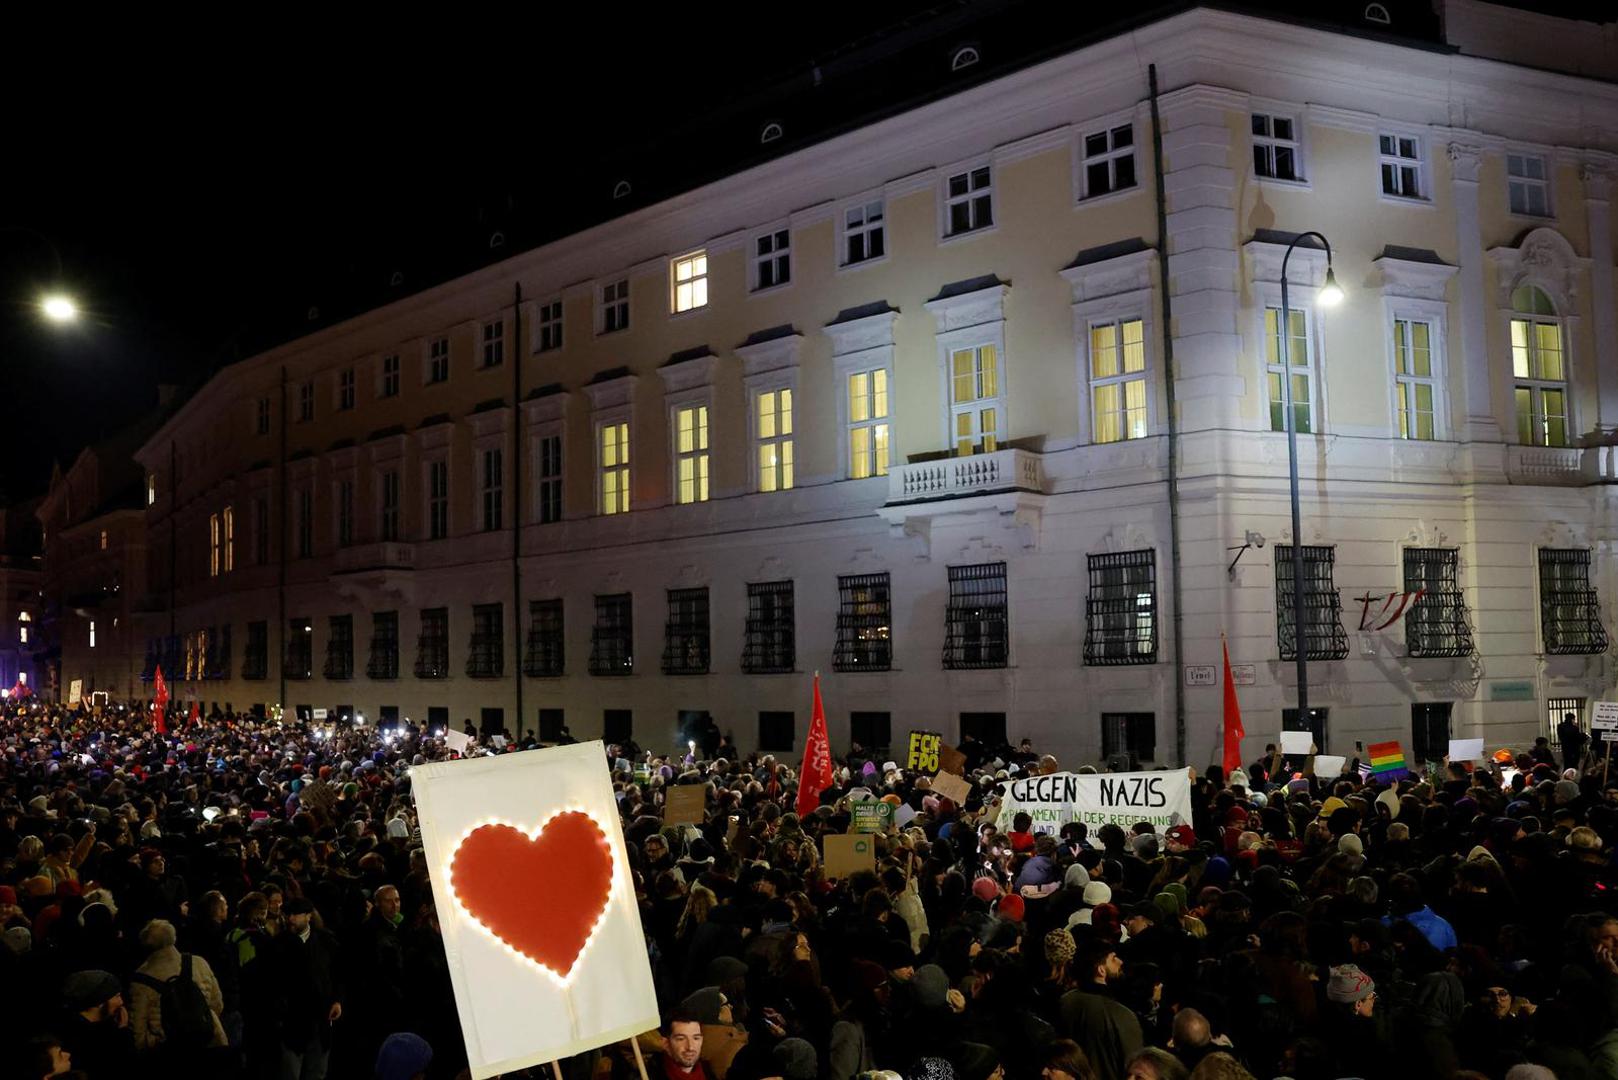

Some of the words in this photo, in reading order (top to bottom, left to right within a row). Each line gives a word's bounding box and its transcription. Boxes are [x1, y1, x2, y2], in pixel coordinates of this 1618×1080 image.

[910, 733, 941, 753] FCK
[1011, 776, 1077, 803] GEGEN
[1100, 777, 1167, 807] NAZIS
[1084, 811, 1105, 825] DER
